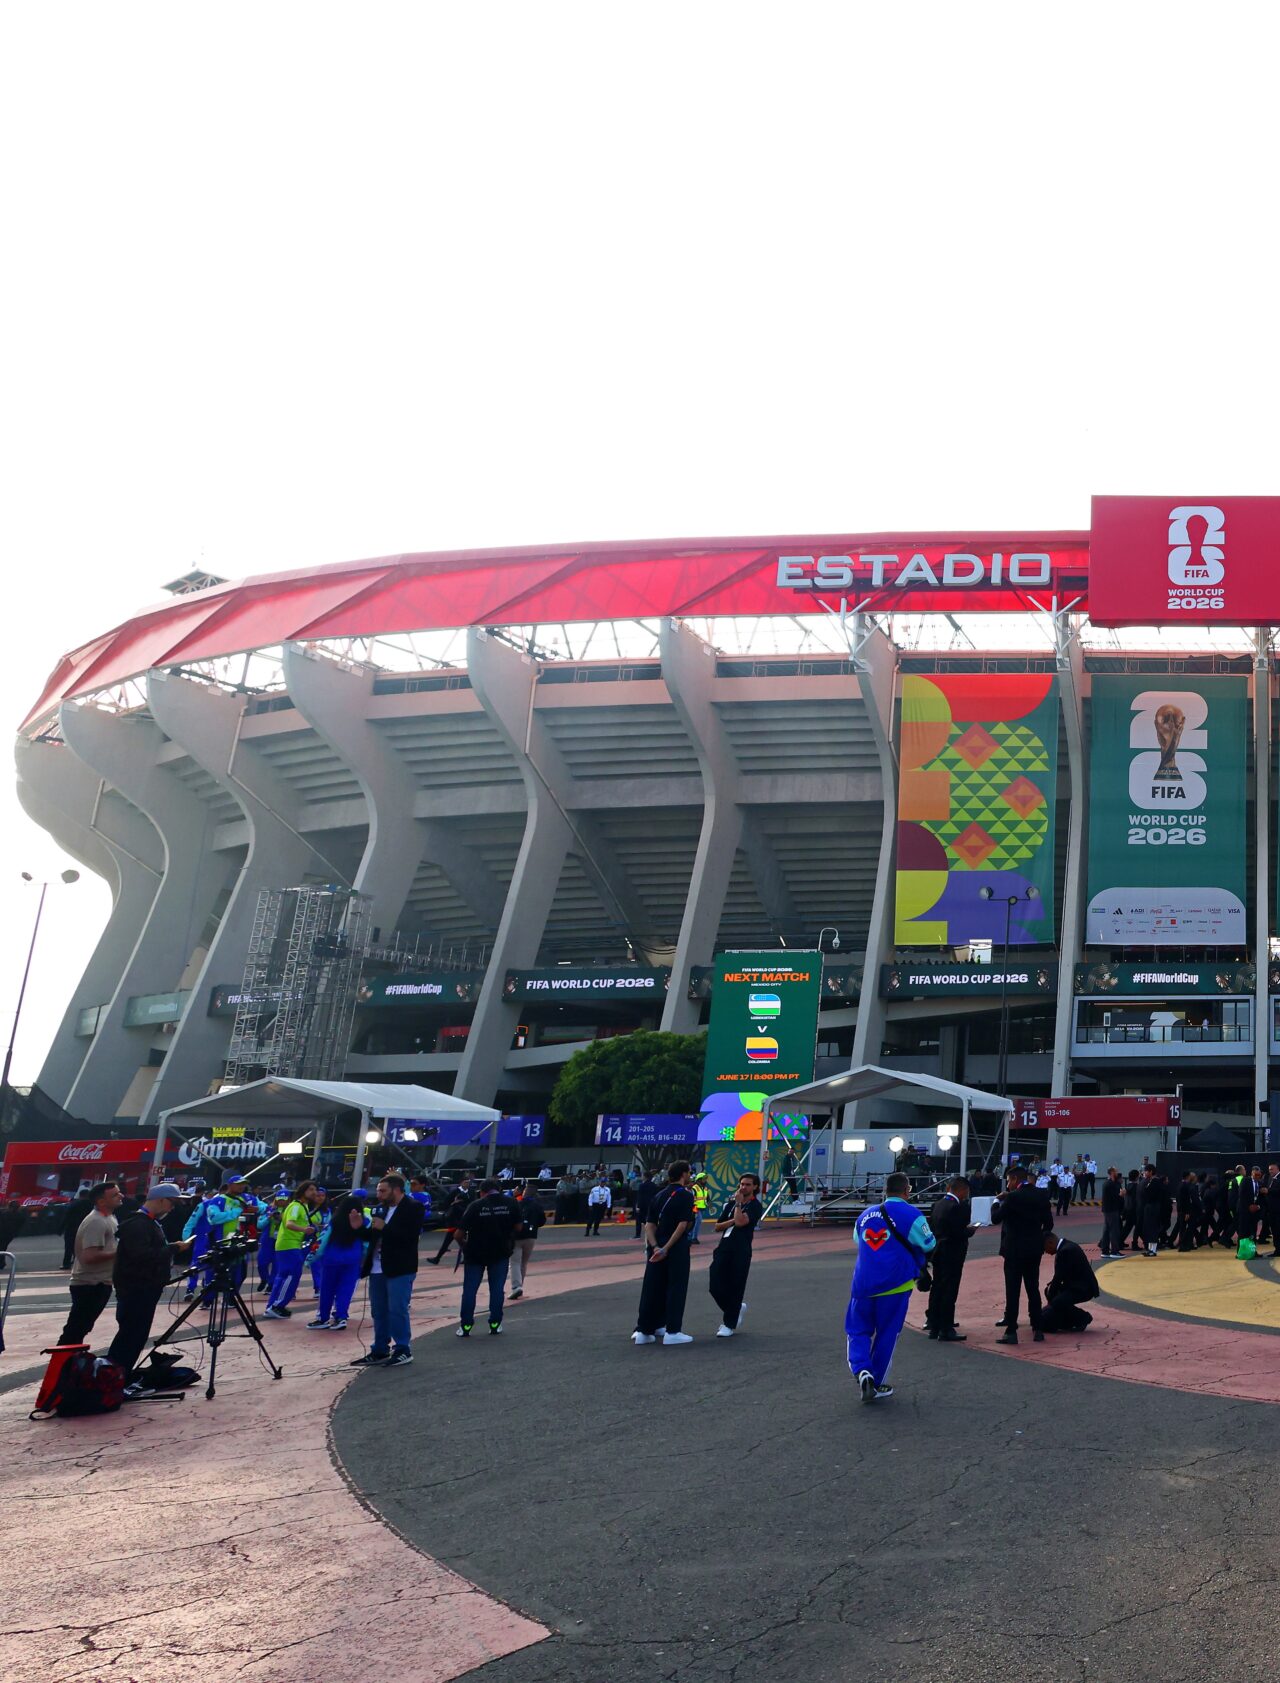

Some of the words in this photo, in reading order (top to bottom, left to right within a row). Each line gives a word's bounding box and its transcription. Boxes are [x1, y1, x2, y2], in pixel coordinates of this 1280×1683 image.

[776, 552, 1051, 588] ESTADIO
[1184, 569, 1210, 578] FIFA
[1167, 588, 1204, 596] WORLD
[1205, 588, 1225, 596] CUP
[1167, 597, 1225, 609] 2026
[1151, 786, 1186, 799] FIFA
[1128, 815, 1177, 826] WORLD
[1180, 815, 1207, 826] CUP
[1127, 828, 1207, 845] 2026
[724, 973, 760, 982] NEXT
[761, 972, 810, 982] MATCH
[909, 975, 931, 984] FIFA
[932, 975, 969, 984] WORLD
[970, 974, 991, 984] CUP
[992, 974, 1029, 983] 2026
[1132, 973, 1199, 985] #FIFAWorldCup
[385, 983, 443, 995] #FIFAWorldCup
[526, 980, 550, 989] FIFA
[551, 979, 590, 989] WORLD
[592, 978, 615, 988] CUP
[615, 978, 655, 988] 2026
[1021, 1110, 1038, 1126] 15
[1169, 1105, 1180, 1119] 15
[523, 1123, 541, 1137] 13
[605, 1126, 622, 1142] 14
[178, 1136, 267, 1168] Corona
